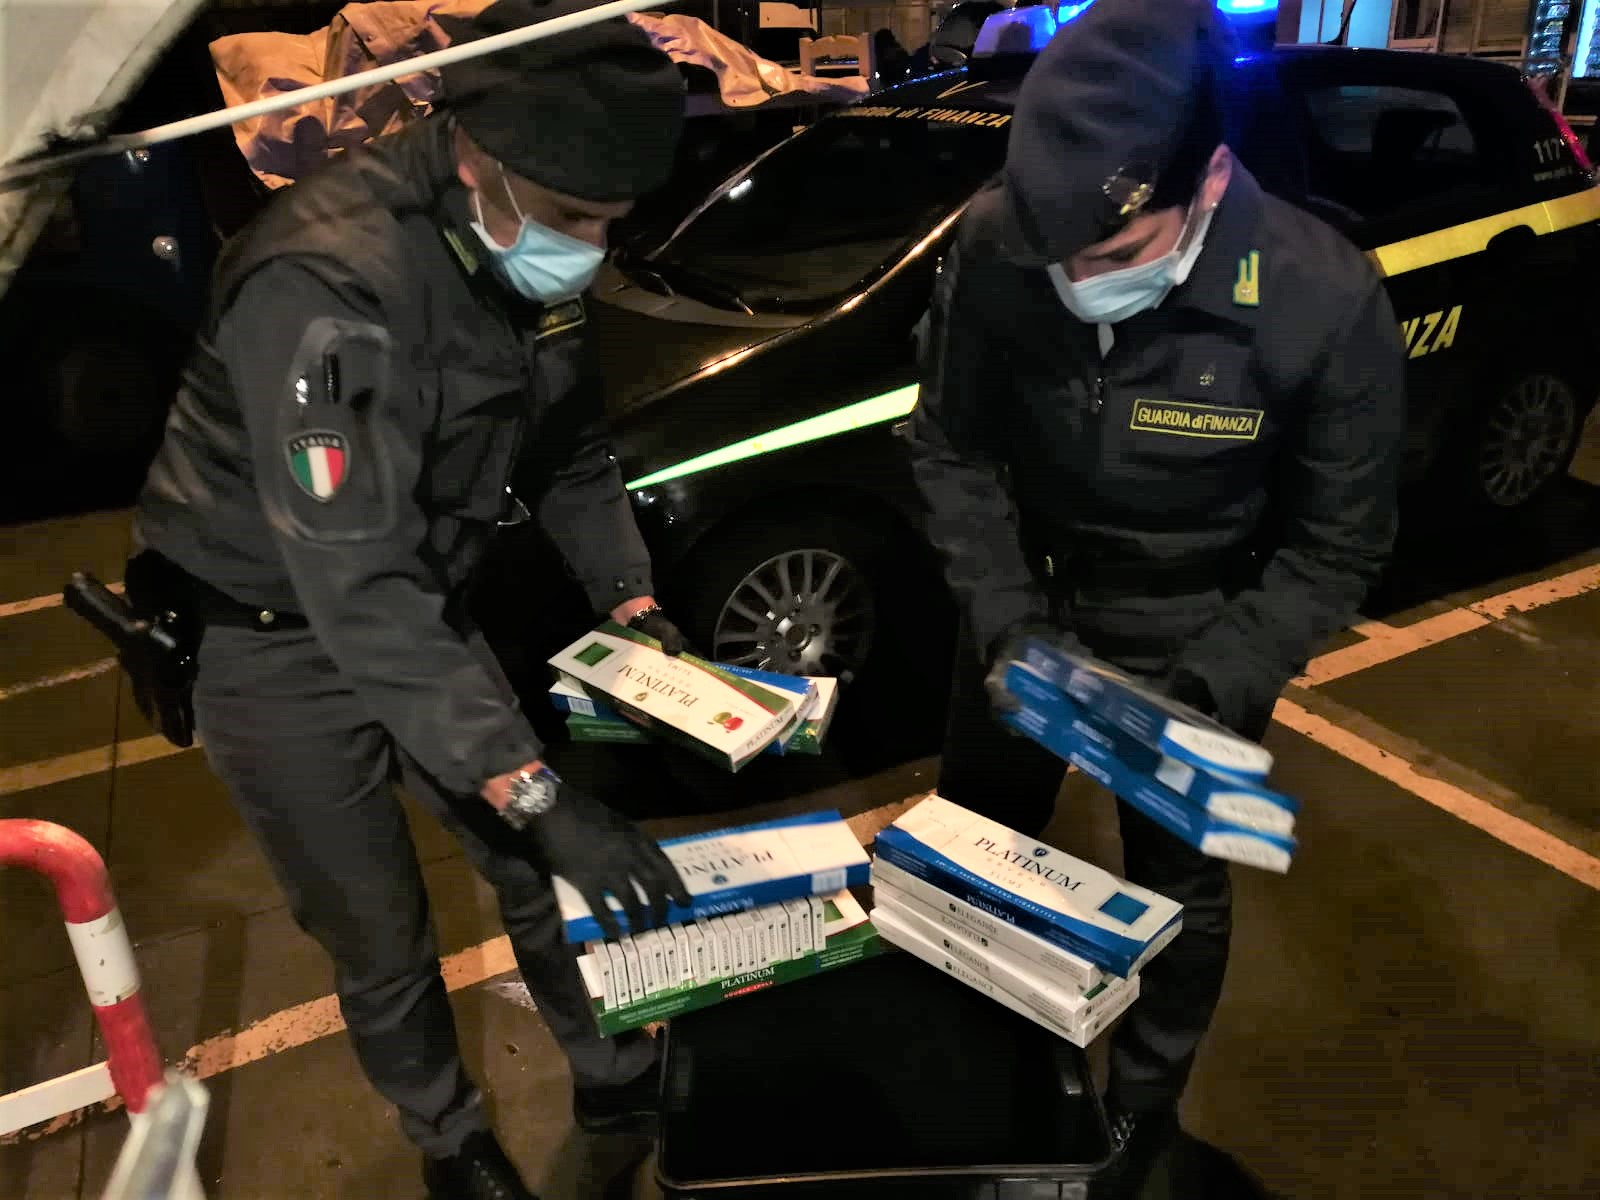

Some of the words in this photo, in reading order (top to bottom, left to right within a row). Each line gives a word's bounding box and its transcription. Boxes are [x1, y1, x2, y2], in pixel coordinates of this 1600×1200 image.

[918, 108, 1012, 128] FINANZA
[1533, 138, 1560, 164] 117
[1138, 407, 1191, 428] GUARDIA
[1203, 413, 1253, 432] FINANZA
[292, 436, 340, 451] ITALIA
[618, 664, 699, 708] PLATINUM
[973, 837, 1086, 892] PLATINUM
[721, 966, 775, 989] PLATINUM
